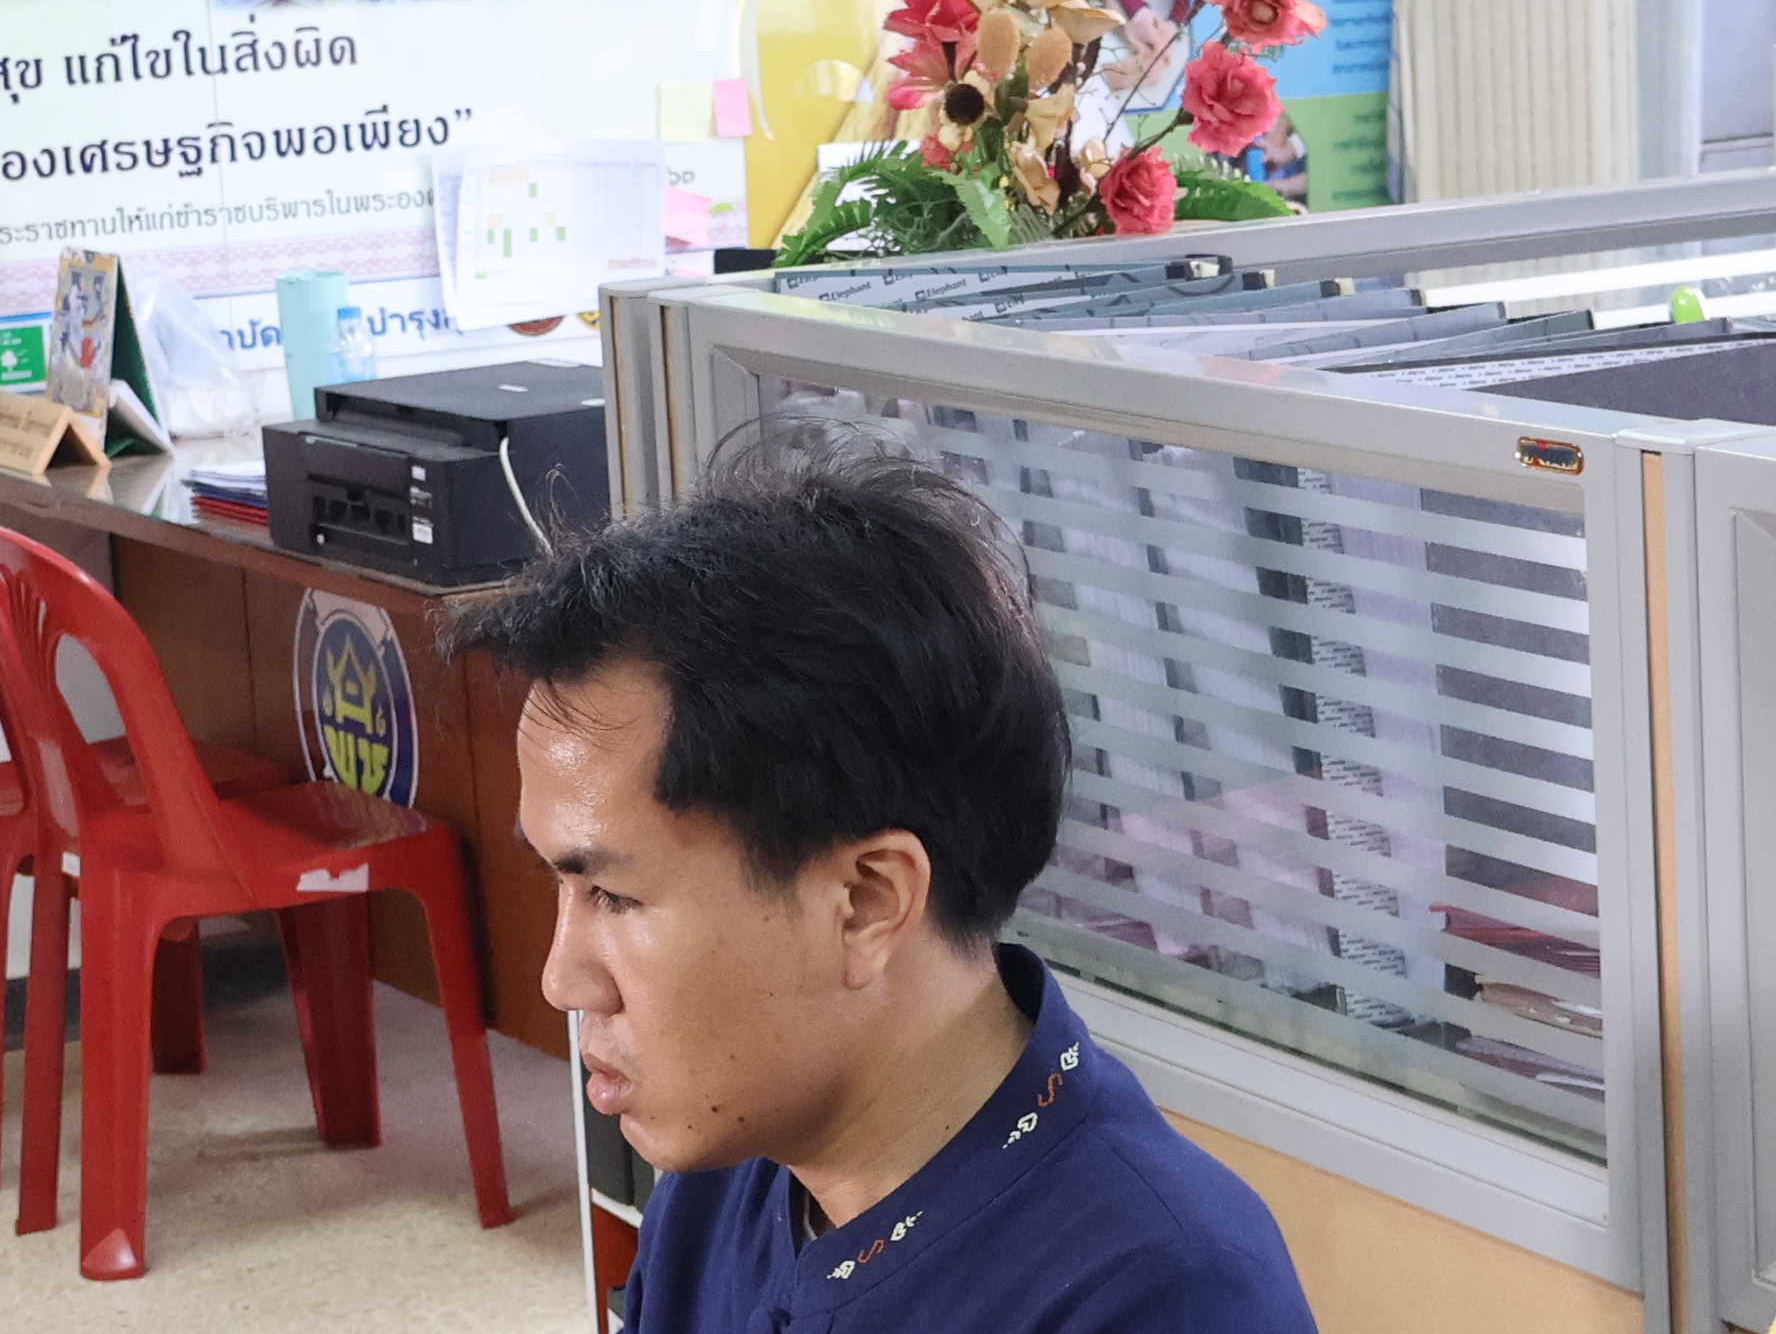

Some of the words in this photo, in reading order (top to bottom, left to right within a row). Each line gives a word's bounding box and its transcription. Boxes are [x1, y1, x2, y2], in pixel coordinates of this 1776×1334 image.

[64, 13, 358, 86] แก้ไขในสิ่งผิด
